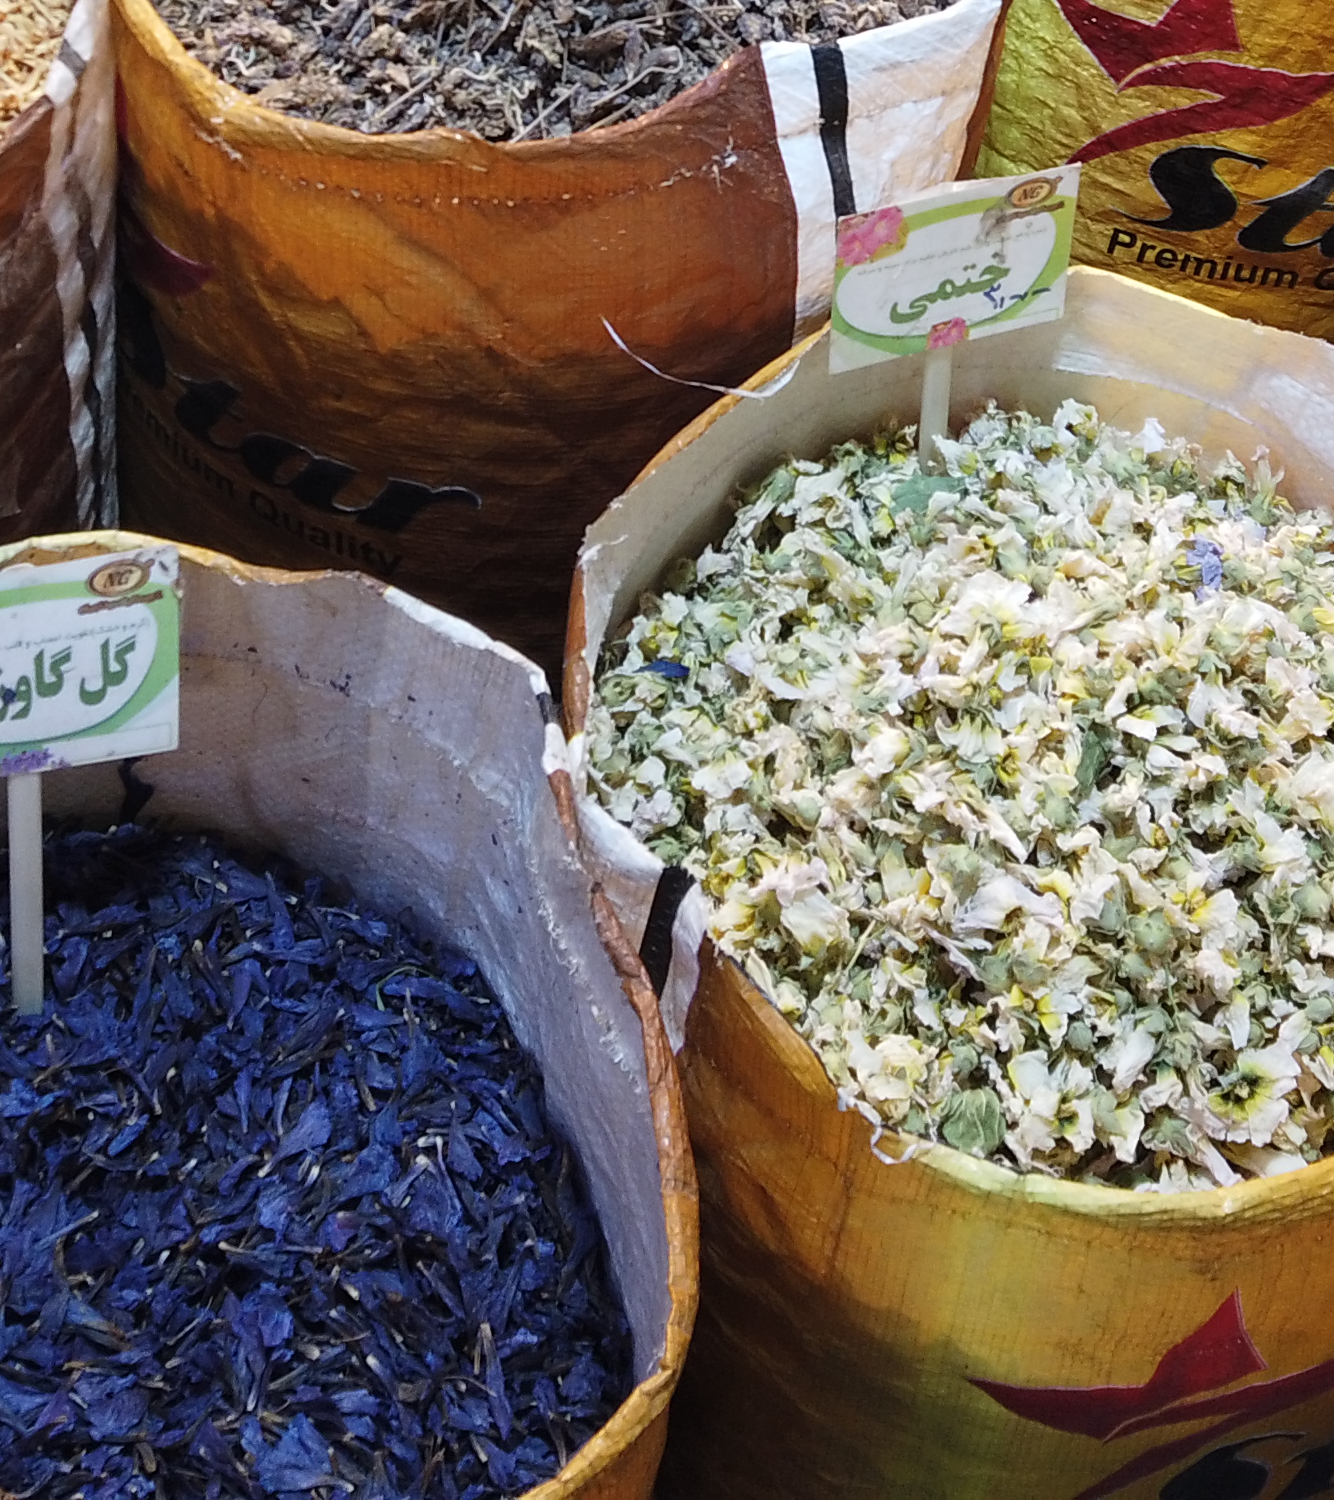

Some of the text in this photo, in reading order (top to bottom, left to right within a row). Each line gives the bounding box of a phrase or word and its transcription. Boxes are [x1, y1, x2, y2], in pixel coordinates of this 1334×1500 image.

[889, 252, 1012, 325] ختمی
[1107, 227, 1300, 290] Premium
[79, 634, 137, 707] گل
